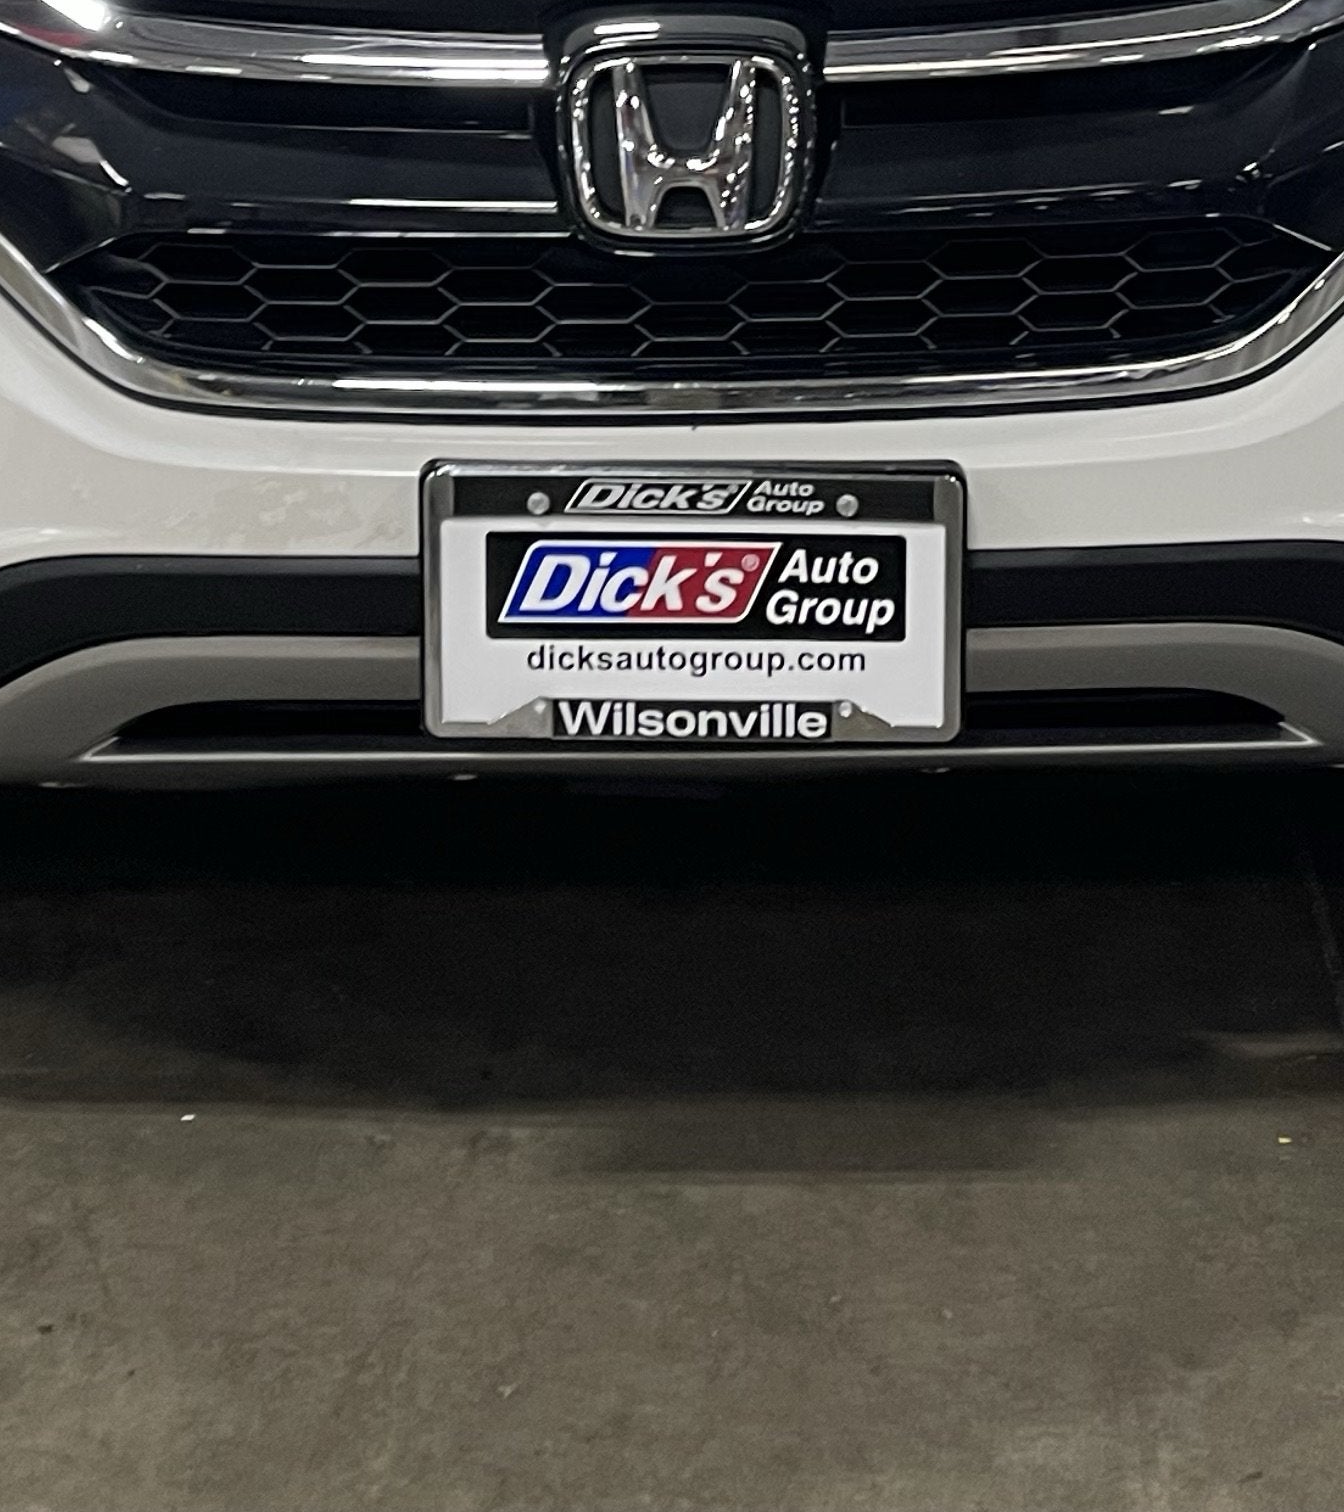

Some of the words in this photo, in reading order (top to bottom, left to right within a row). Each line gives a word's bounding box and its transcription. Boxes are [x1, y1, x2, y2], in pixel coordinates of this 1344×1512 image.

[752, 480, 815, 497] Auto
[746, 498, 825, 516] Group
[519, 551, 745, 613] Dick's
[777, 549, 880, 585] Auto
[765, 589, 896, 634] Group
[526, 645, 867, 677] dicksautogroup.com
[557, 700, 828, 739] Wilsonville
